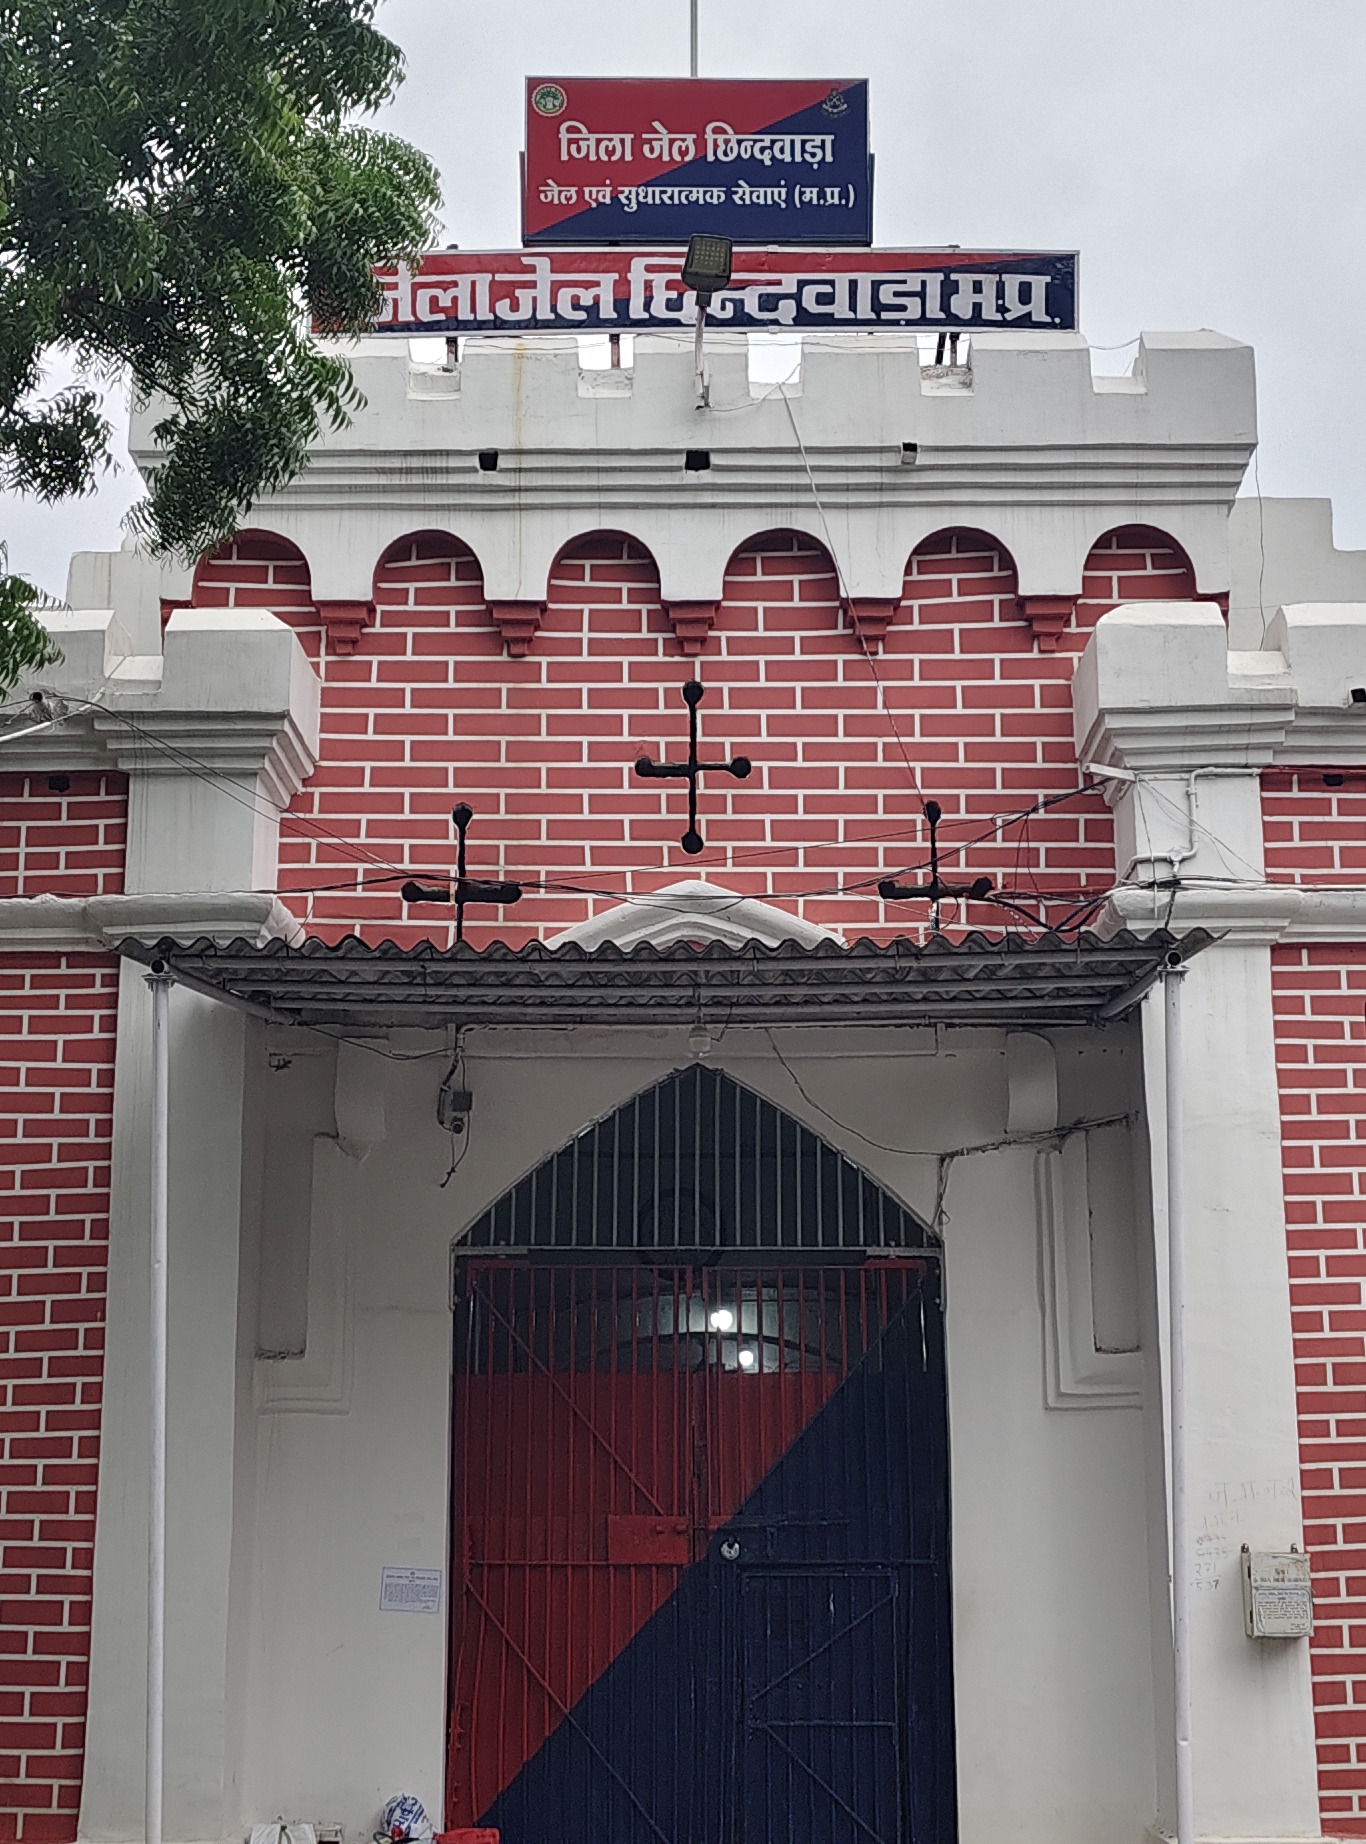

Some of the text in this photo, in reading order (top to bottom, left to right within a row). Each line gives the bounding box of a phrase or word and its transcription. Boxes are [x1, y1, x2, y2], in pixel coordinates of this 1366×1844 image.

[558, 120, 835, 170] जिला जेल छिन्दवाड़ा
[538, 178, 856, 213] जेल एवं सुधारात्मक सेवाएं (म.प्र.)
[371, 257, 493, 323] जला
